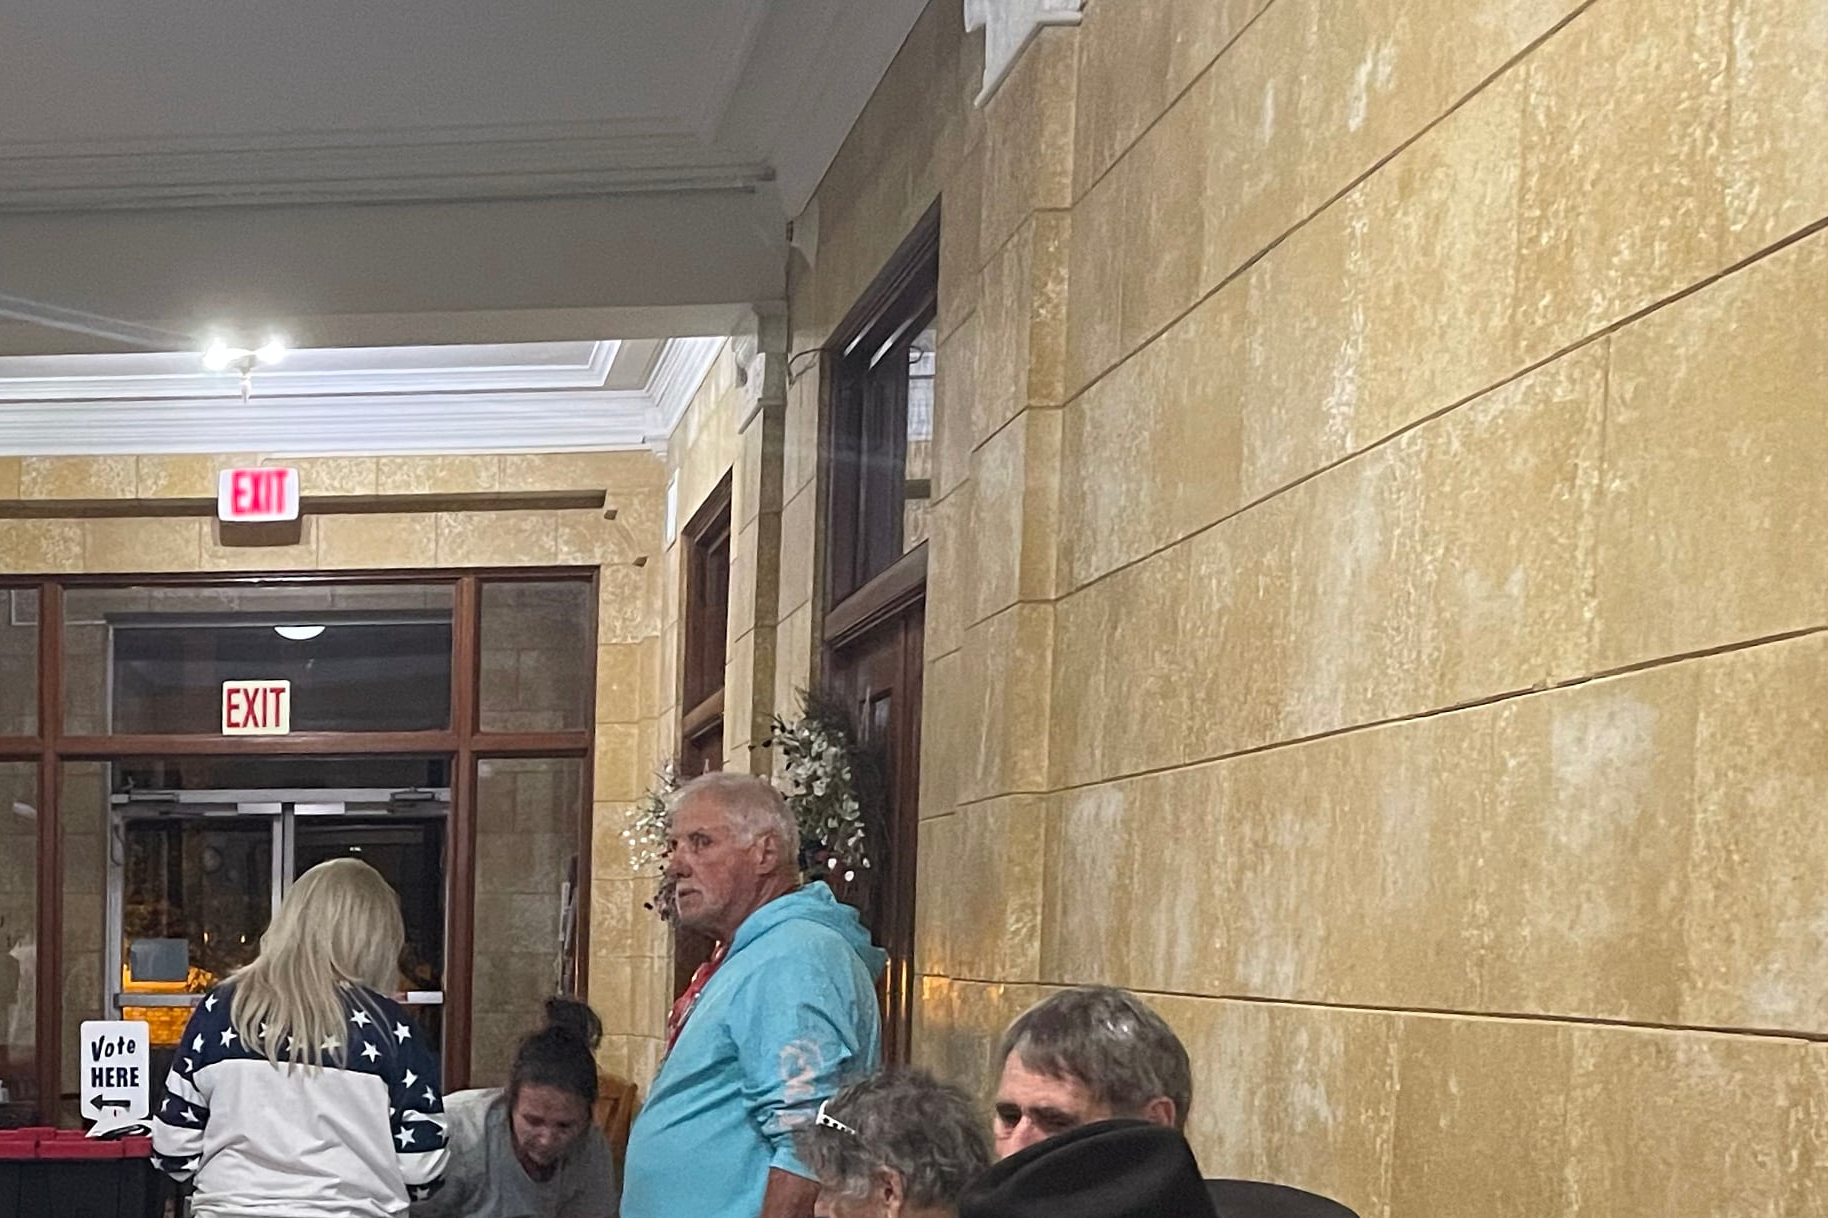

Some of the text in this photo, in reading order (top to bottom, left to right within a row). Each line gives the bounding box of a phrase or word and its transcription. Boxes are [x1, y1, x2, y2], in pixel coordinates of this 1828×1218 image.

[231, 470, 289, 516] EXIT
[226, 688, 286, 728] EXIT
[91, 1035, 136, 1062] Vote
[91, 1067, 139, 1088] HERE
